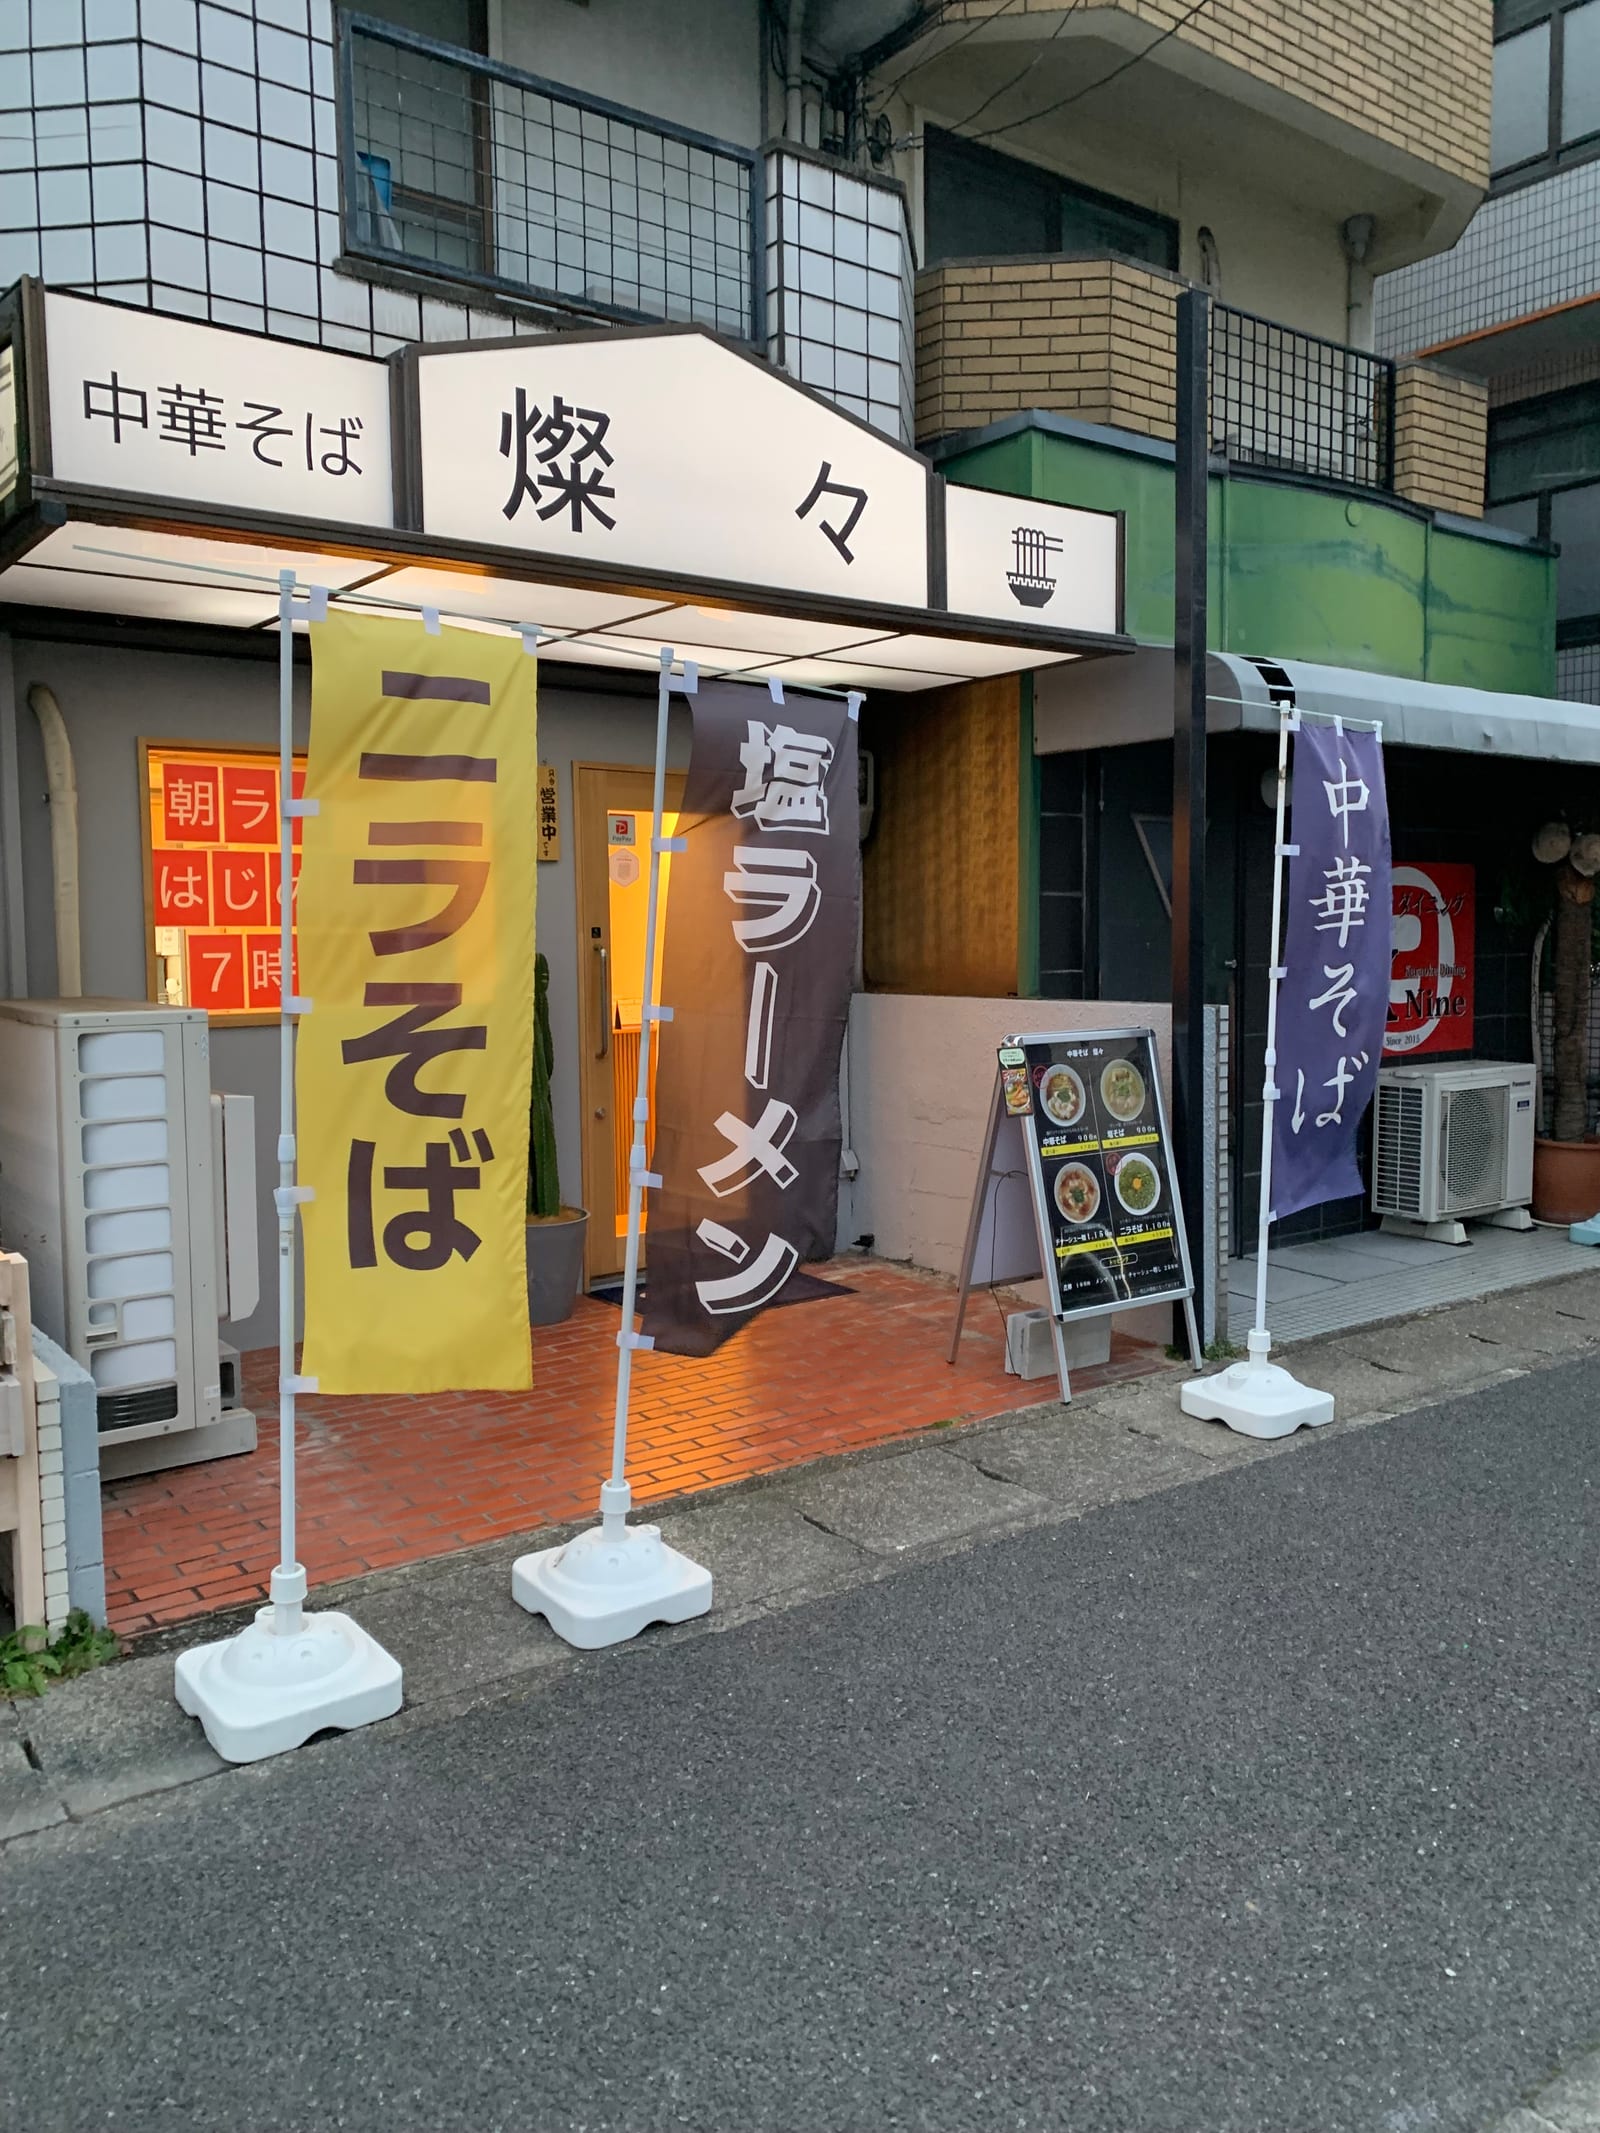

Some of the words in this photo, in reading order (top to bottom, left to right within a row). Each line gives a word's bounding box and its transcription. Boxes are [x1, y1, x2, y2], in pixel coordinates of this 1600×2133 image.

[82, 370, 364, 477] 中華そば
[498, 385, 869, 566] 燦々
[341, 669, 498, 1271] ニラそば
[695, 720, 835, 1316] 塩ラーメン
[1290, 758, 1372, 1136] 中華そば
[1405, 988, 1467, 1020] Nine
